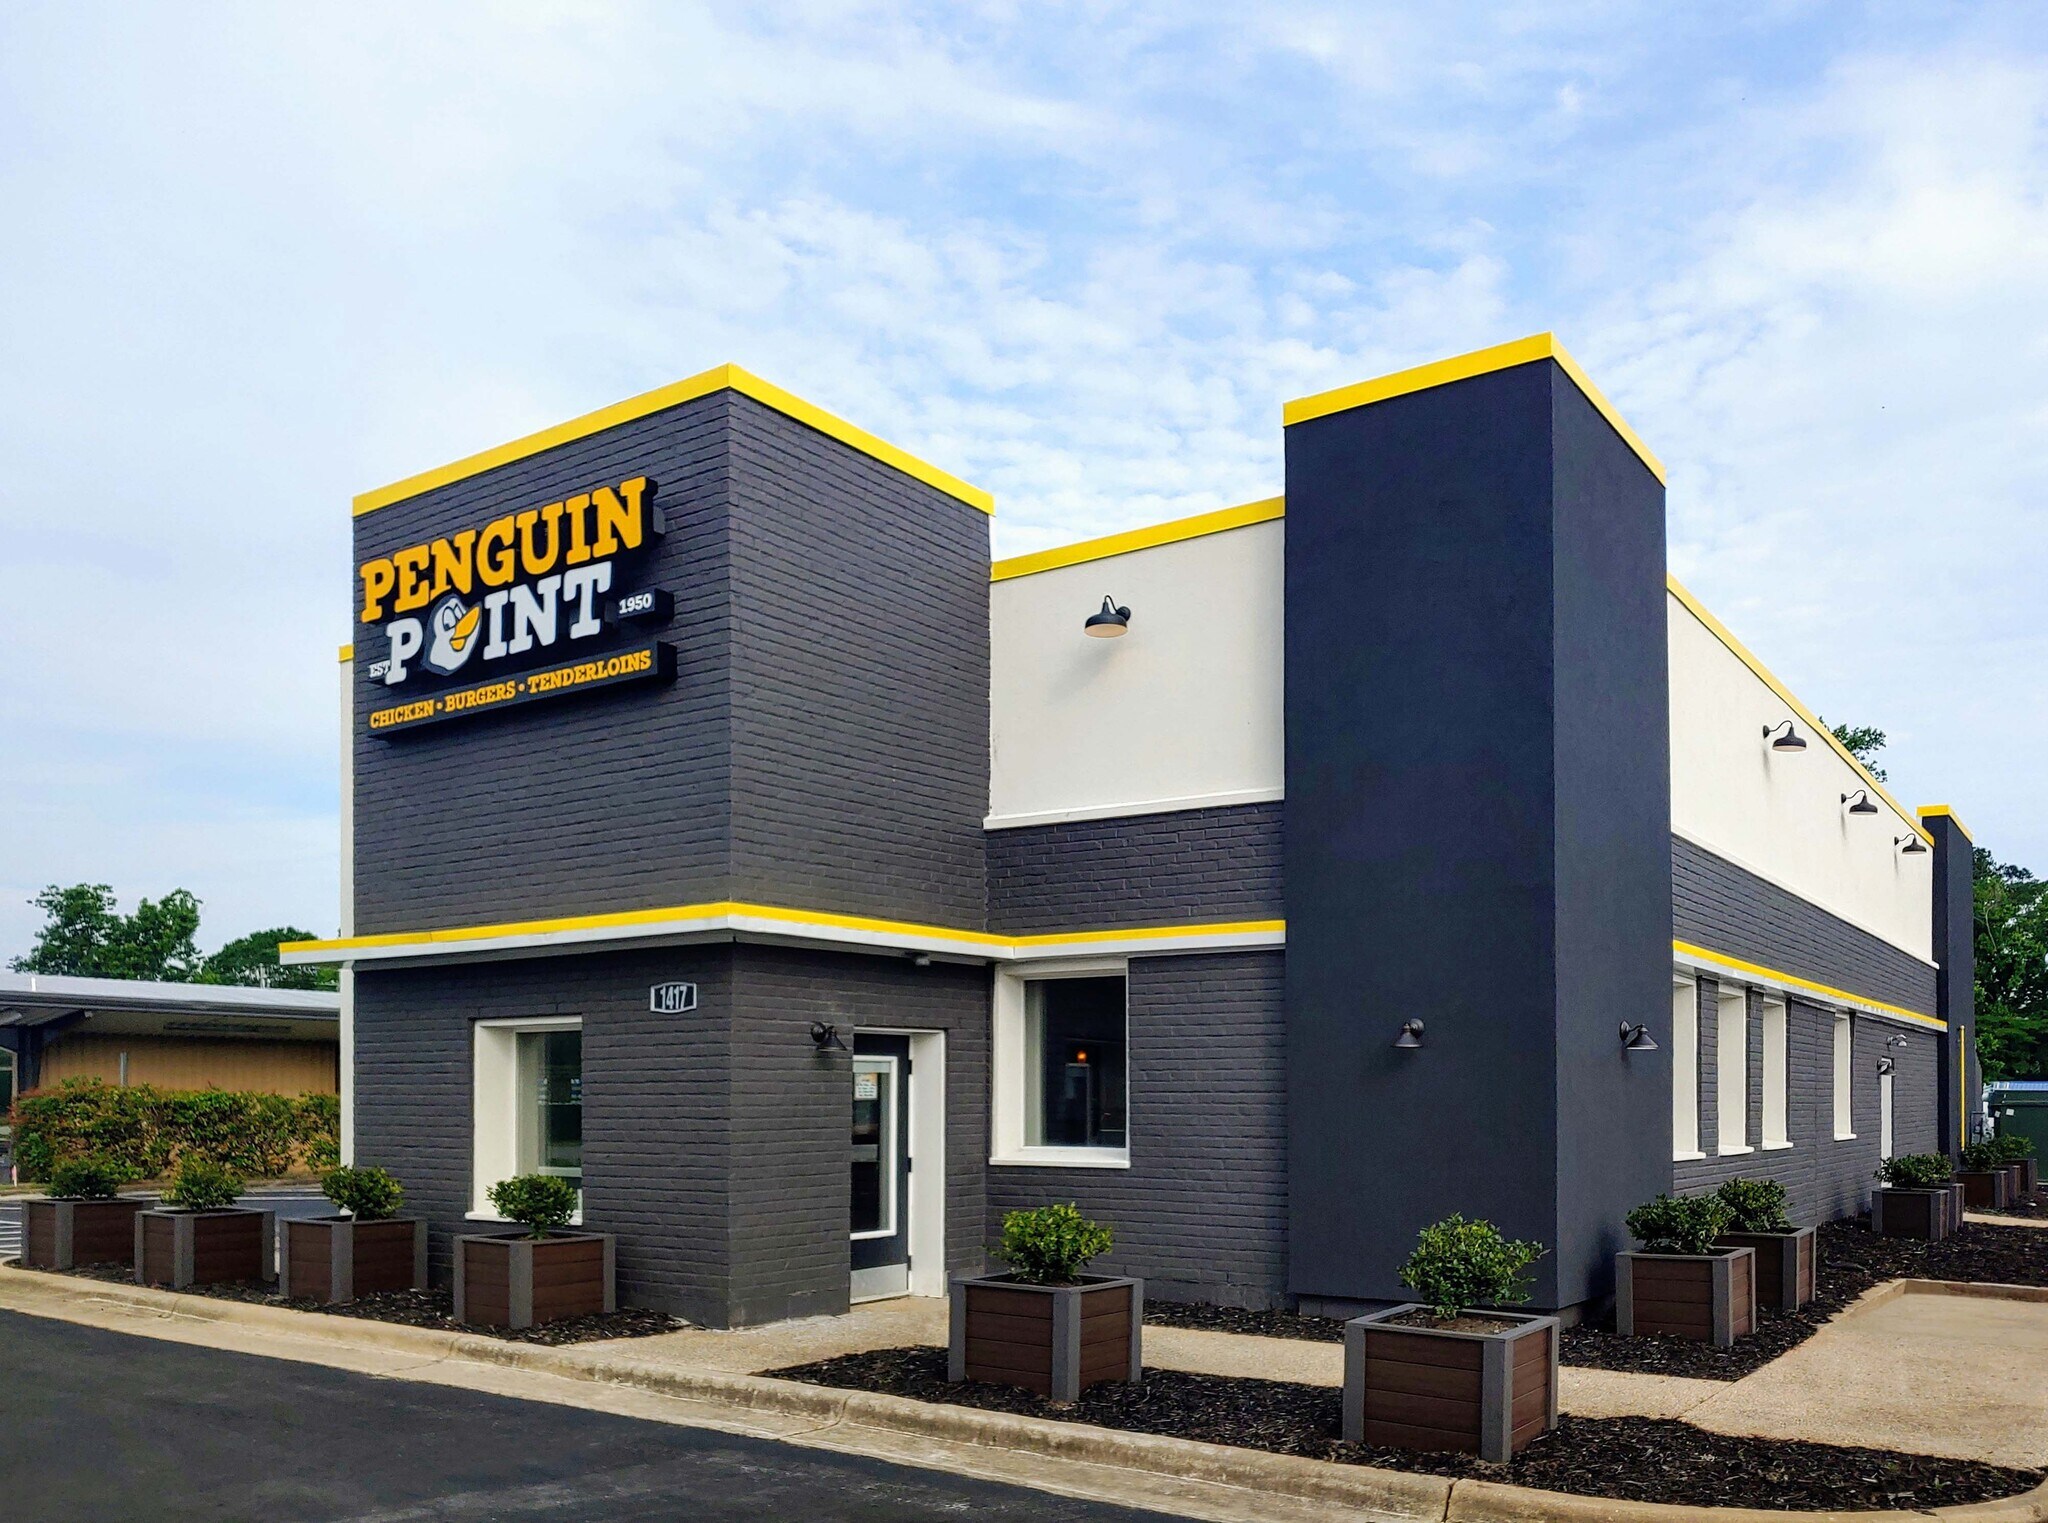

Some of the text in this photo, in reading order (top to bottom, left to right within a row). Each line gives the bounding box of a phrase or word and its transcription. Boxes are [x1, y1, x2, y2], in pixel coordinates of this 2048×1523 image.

[360, 476, 646, 623] PENGUIN
[619, 593, 652, 614] 1950
[370, 650, 652, 729] CHICKEN BURGERS TENDERLOINS
[660, 985, 687, 1010] 1417
